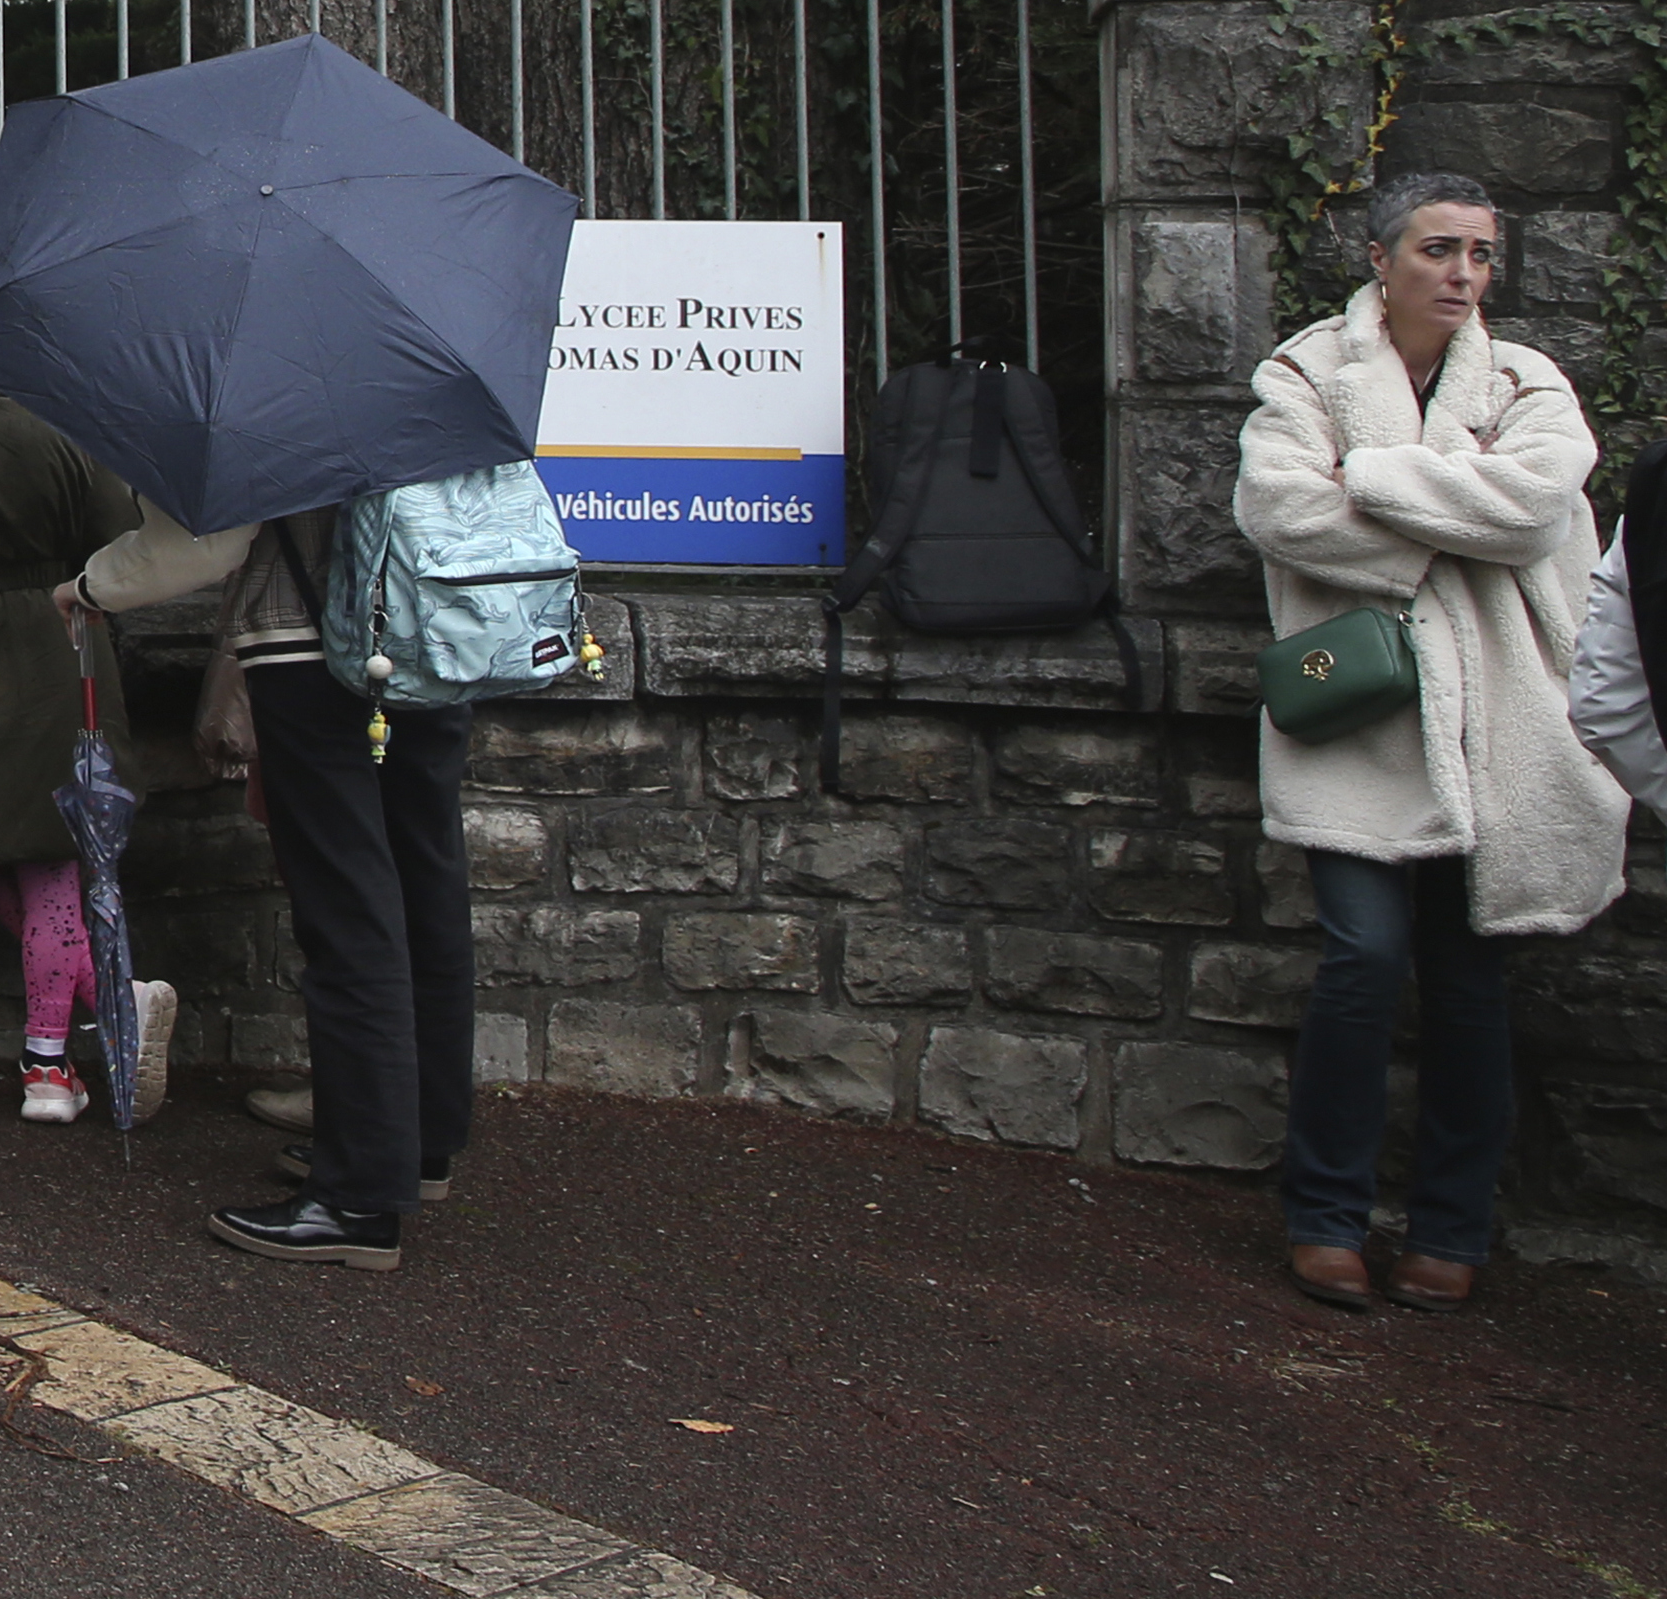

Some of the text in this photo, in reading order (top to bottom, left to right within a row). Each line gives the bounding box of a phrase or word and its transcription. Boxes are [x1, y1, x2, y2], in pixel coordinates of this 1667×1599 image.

[555, 296, 803, 331] LYCEE PRIVES
[651, 339, 804, 377] D'AQUIN
[556, 490, 814, 524] Véhicules Autorisés
